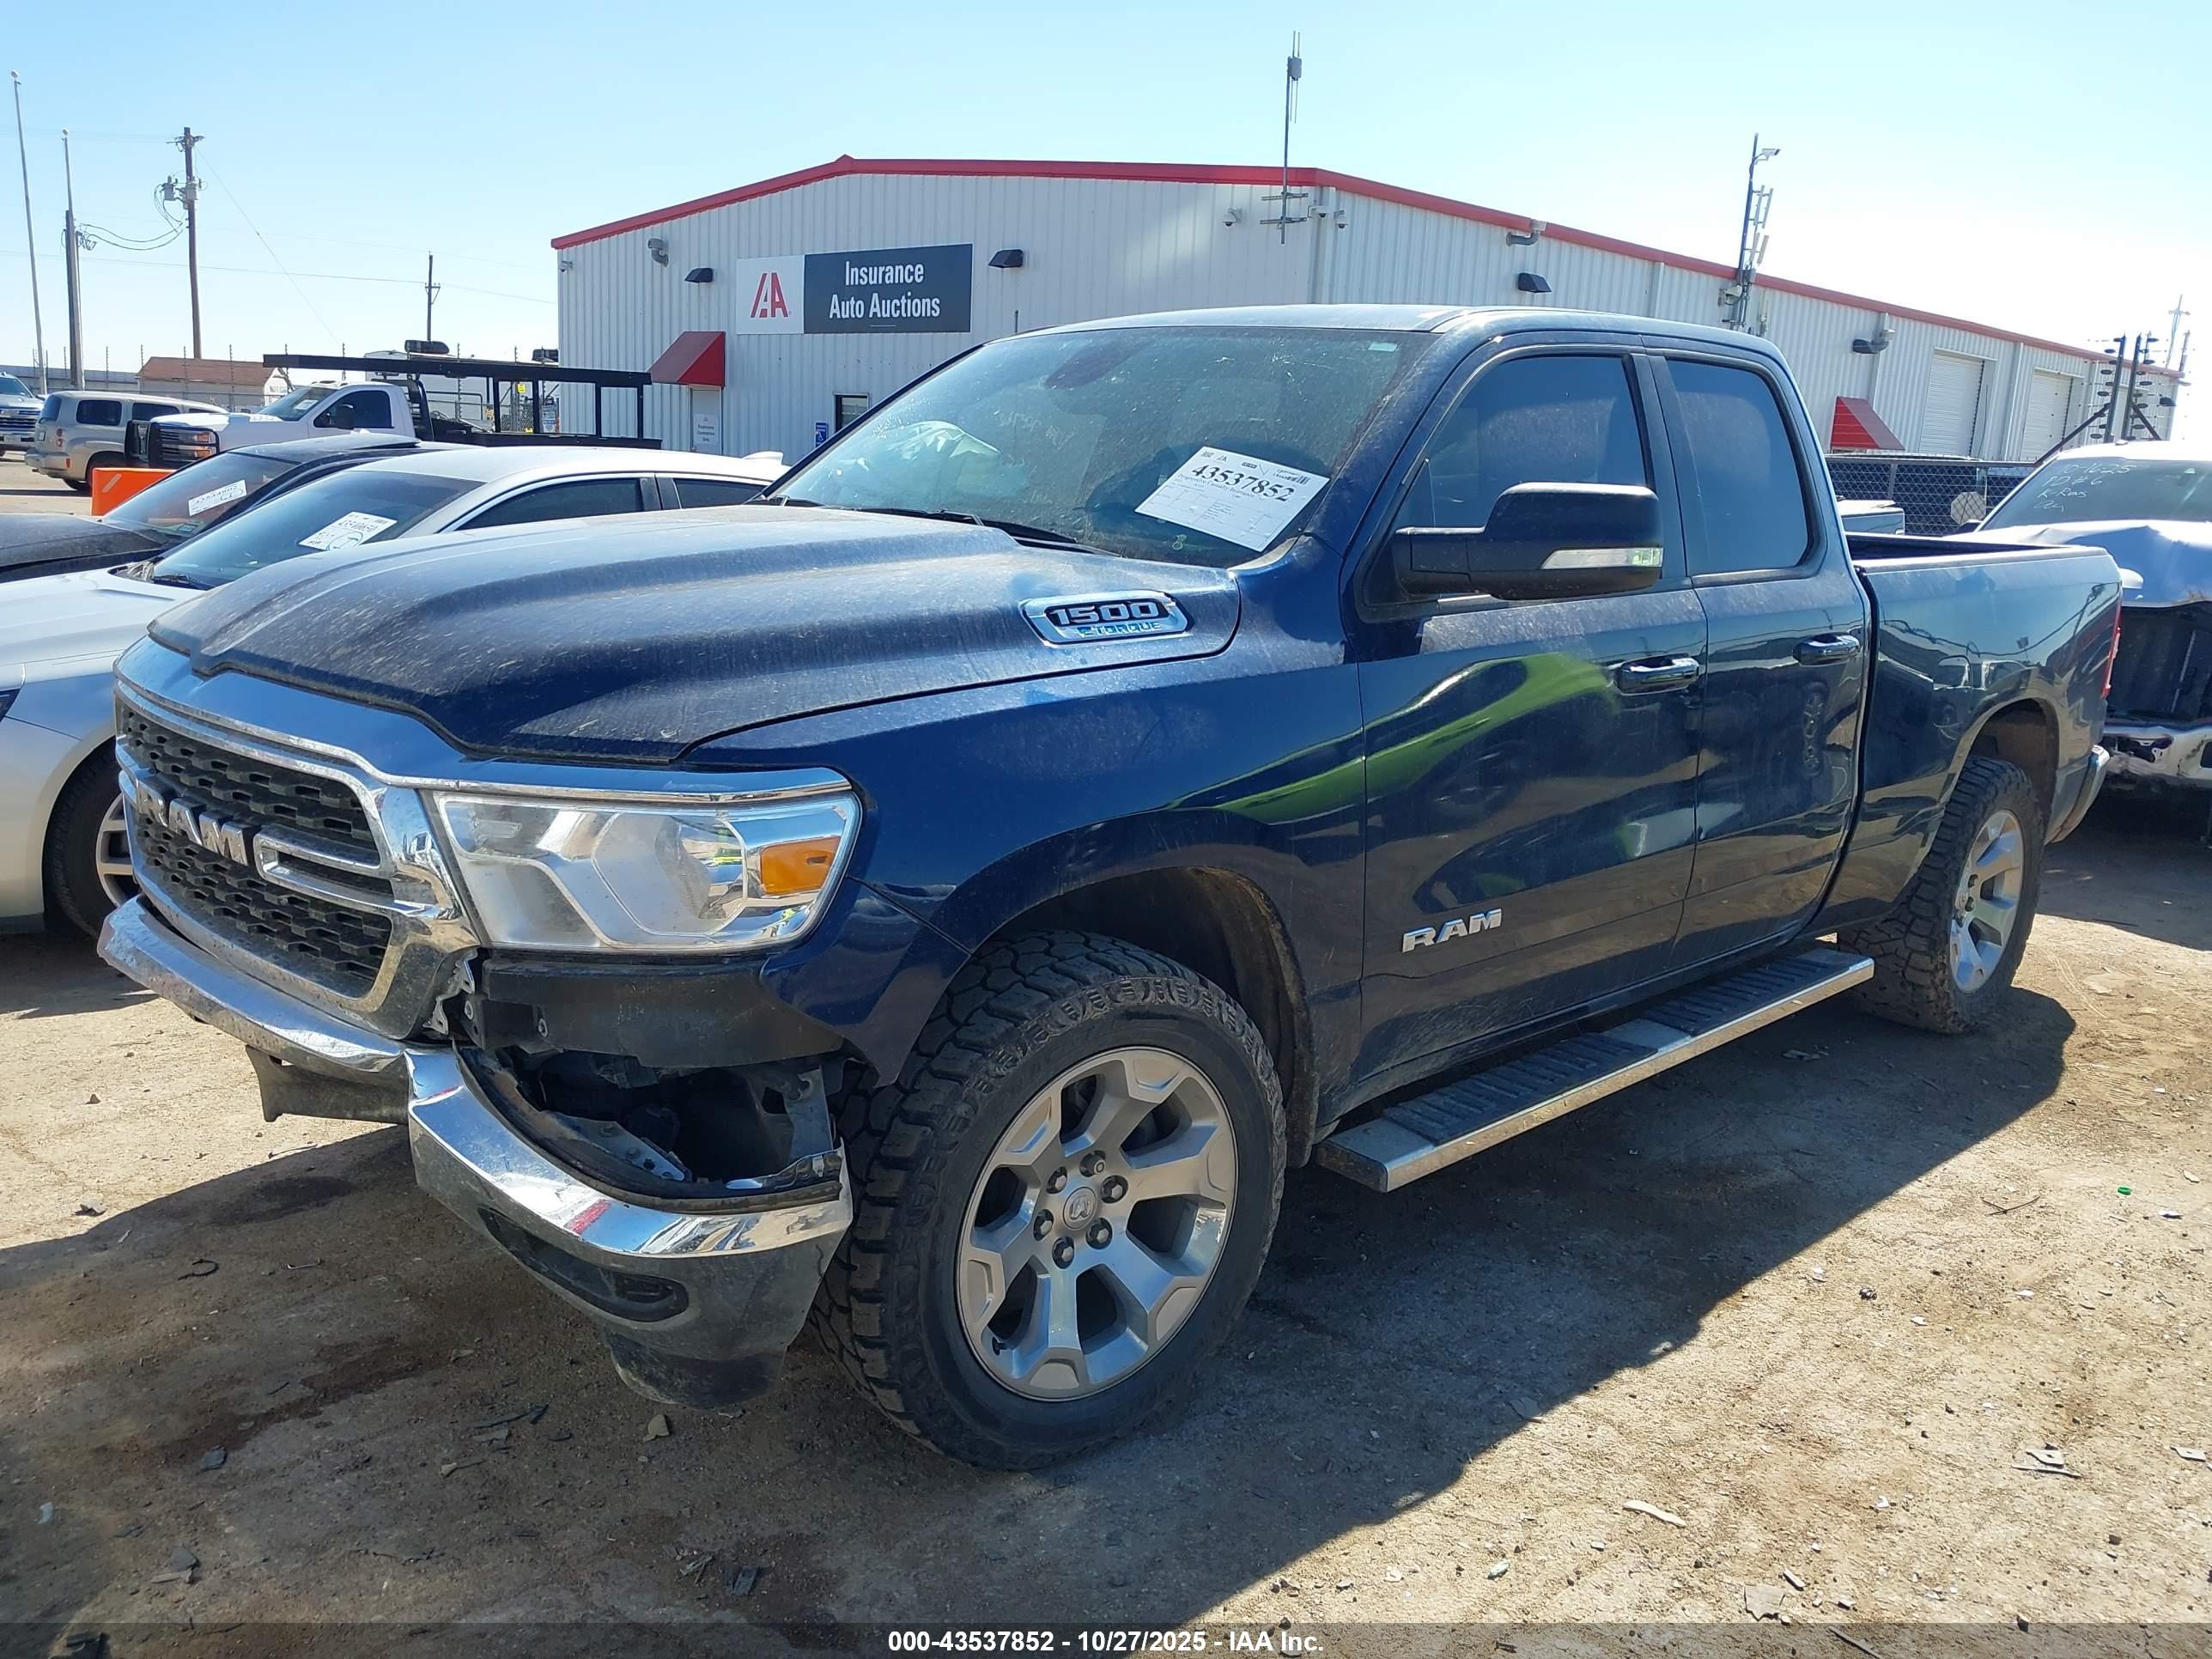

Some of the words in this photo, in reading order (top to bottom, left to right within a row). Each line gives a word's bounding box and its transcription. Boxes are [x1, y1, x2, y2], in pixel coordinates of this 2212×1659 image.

[845, 260, 925, 286] Insurance
[829, 293, 865, 319] Auto
[869, 292, 941, 319] Auctions
[1191, 464, 1295, 502] 43537852
[1050, 601, 1159, 625] 1500
[137, 777, 248, 866] RAM
[1402, 908, 1502, 953] RAM
